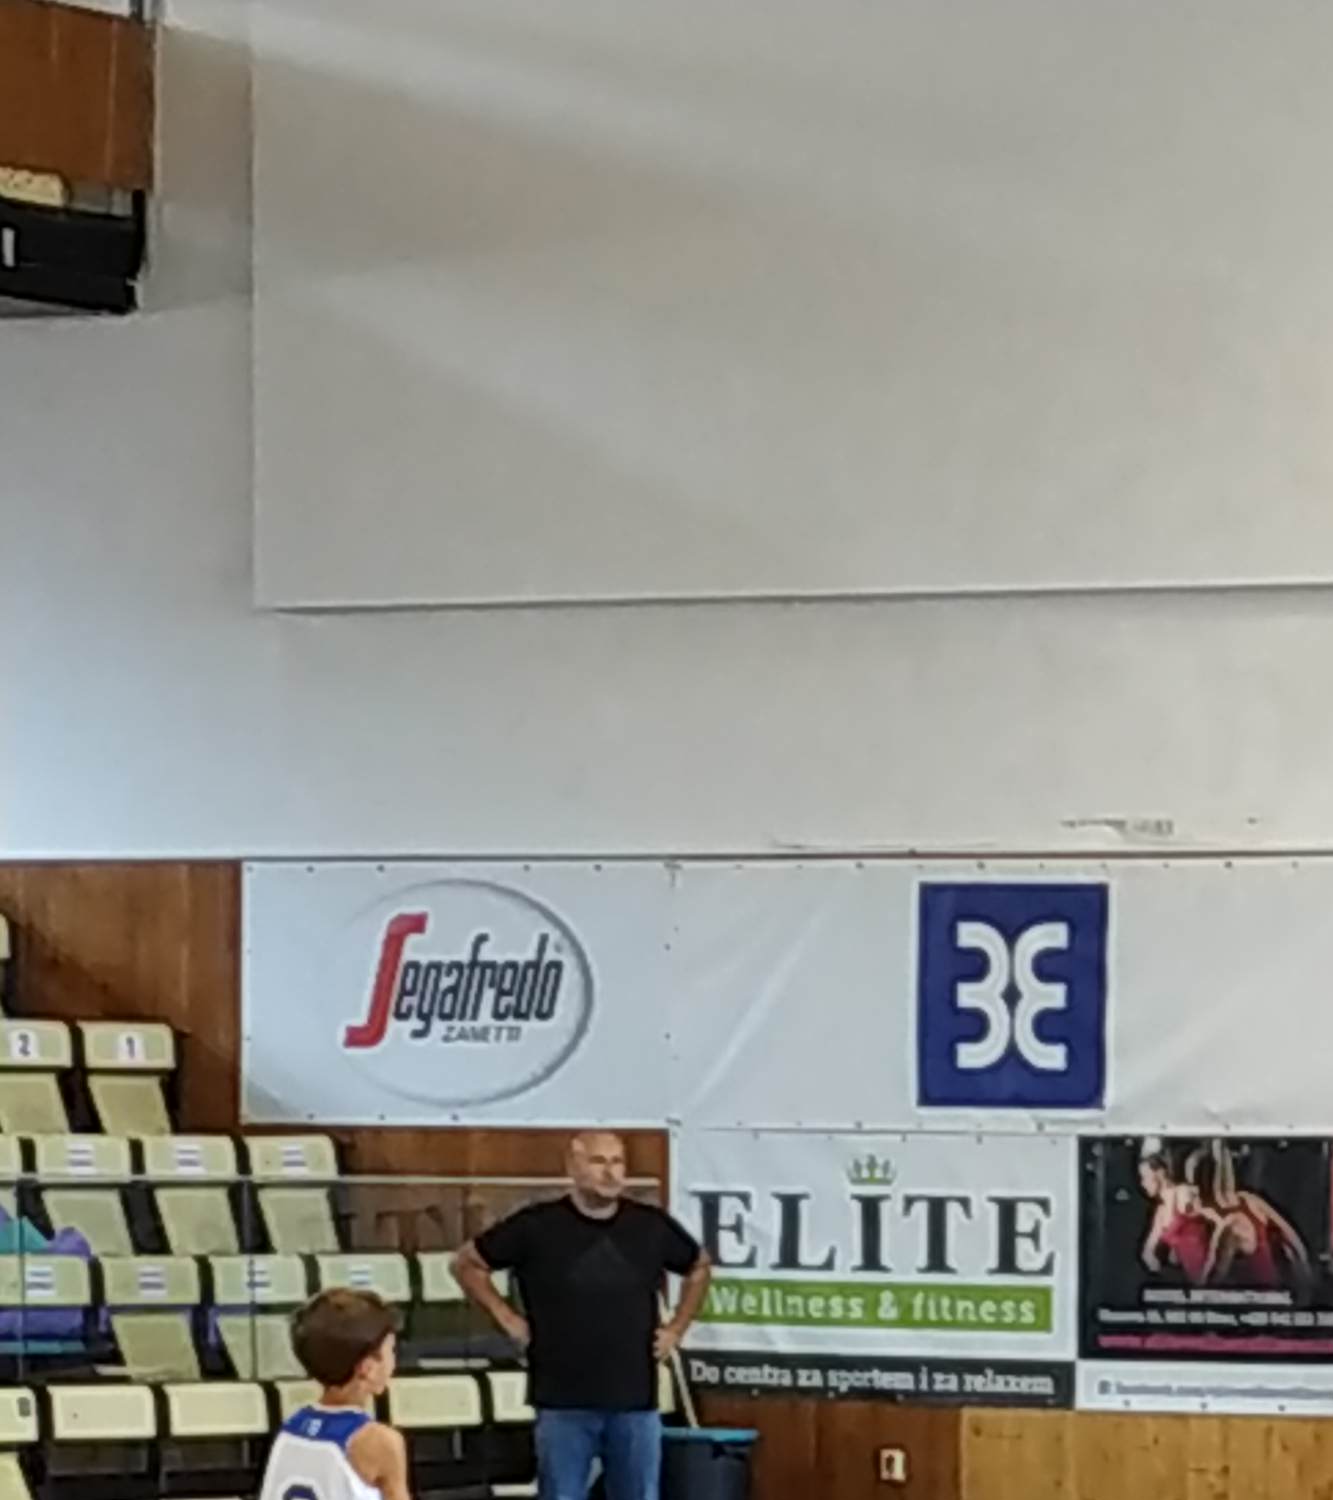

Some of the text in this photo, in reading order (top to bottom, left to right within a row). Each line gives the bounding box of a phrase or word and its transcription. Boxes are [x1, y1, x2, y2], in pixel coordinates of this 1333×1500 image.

[343, 912, 564, 1048] Segafredo
[441, 1026, 522, 1042] ZANETTI
[690, 1190, 1055, 1276] ELITE
[708, 1284, 1036, 1325] Wellness & fitness
[689, 1359, 719, 1383] Do
[724, 1363, 792, 1388] centra
